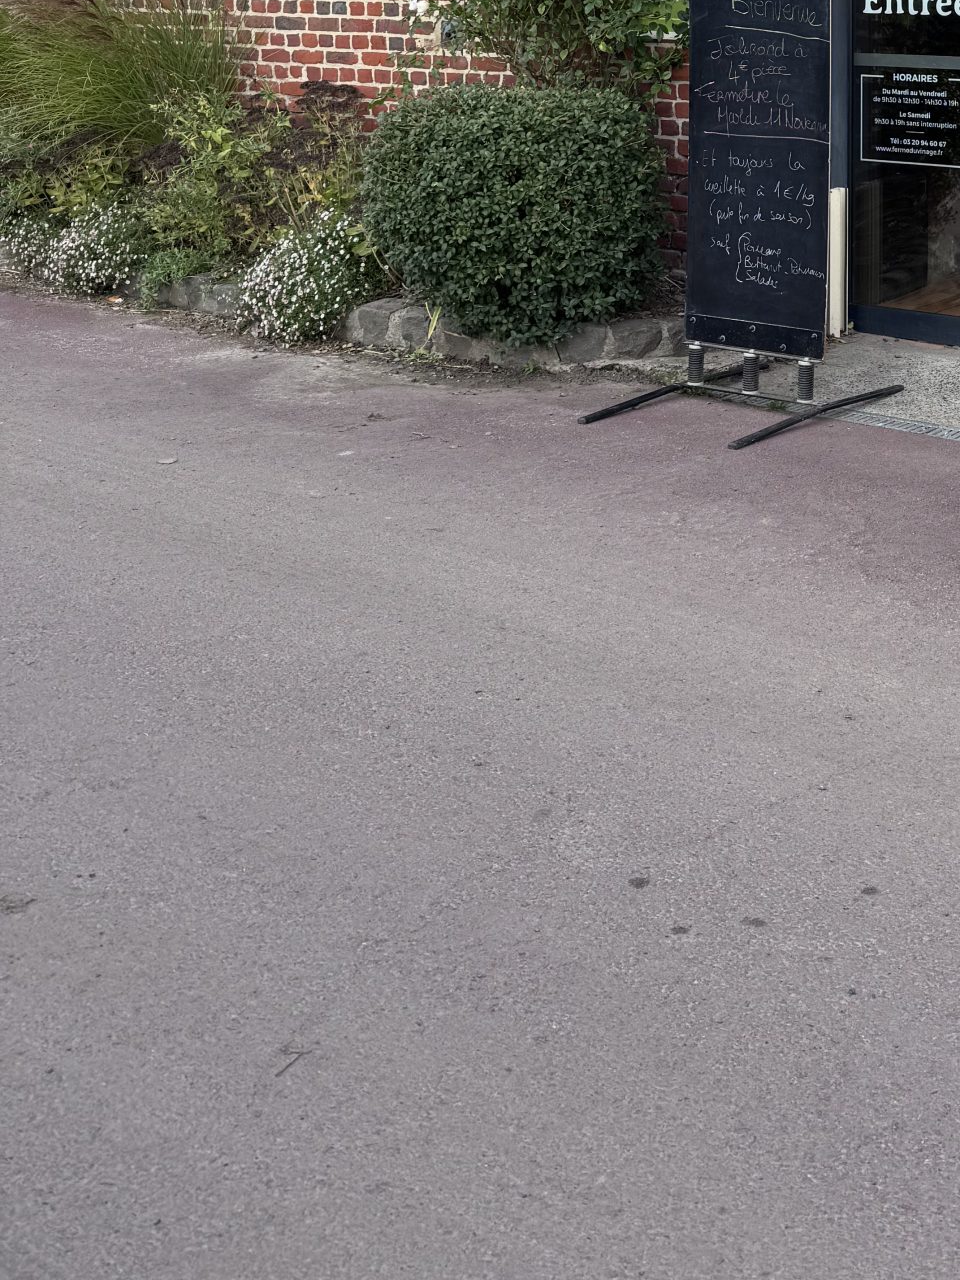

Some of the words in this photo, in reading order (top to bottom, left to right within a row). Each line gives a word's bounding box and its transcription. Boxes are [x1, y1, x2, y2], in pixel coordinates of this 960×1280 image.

[892, 73, 938, 83] HORAIRES
[891, 88, 910, 96] Mardi
[919, 90, 948, 98] Vendredi
[902, 97, 920, 105] 12h30
[924, 98, 942, 106] 14h30
[907, 111, 931, 120] Samedi
[894, 118, 906, 126] 19h
[920, 120, 958, 130] interruption
[728, 148, 774, 177] toujours
[788, 151, 806, 171] la
